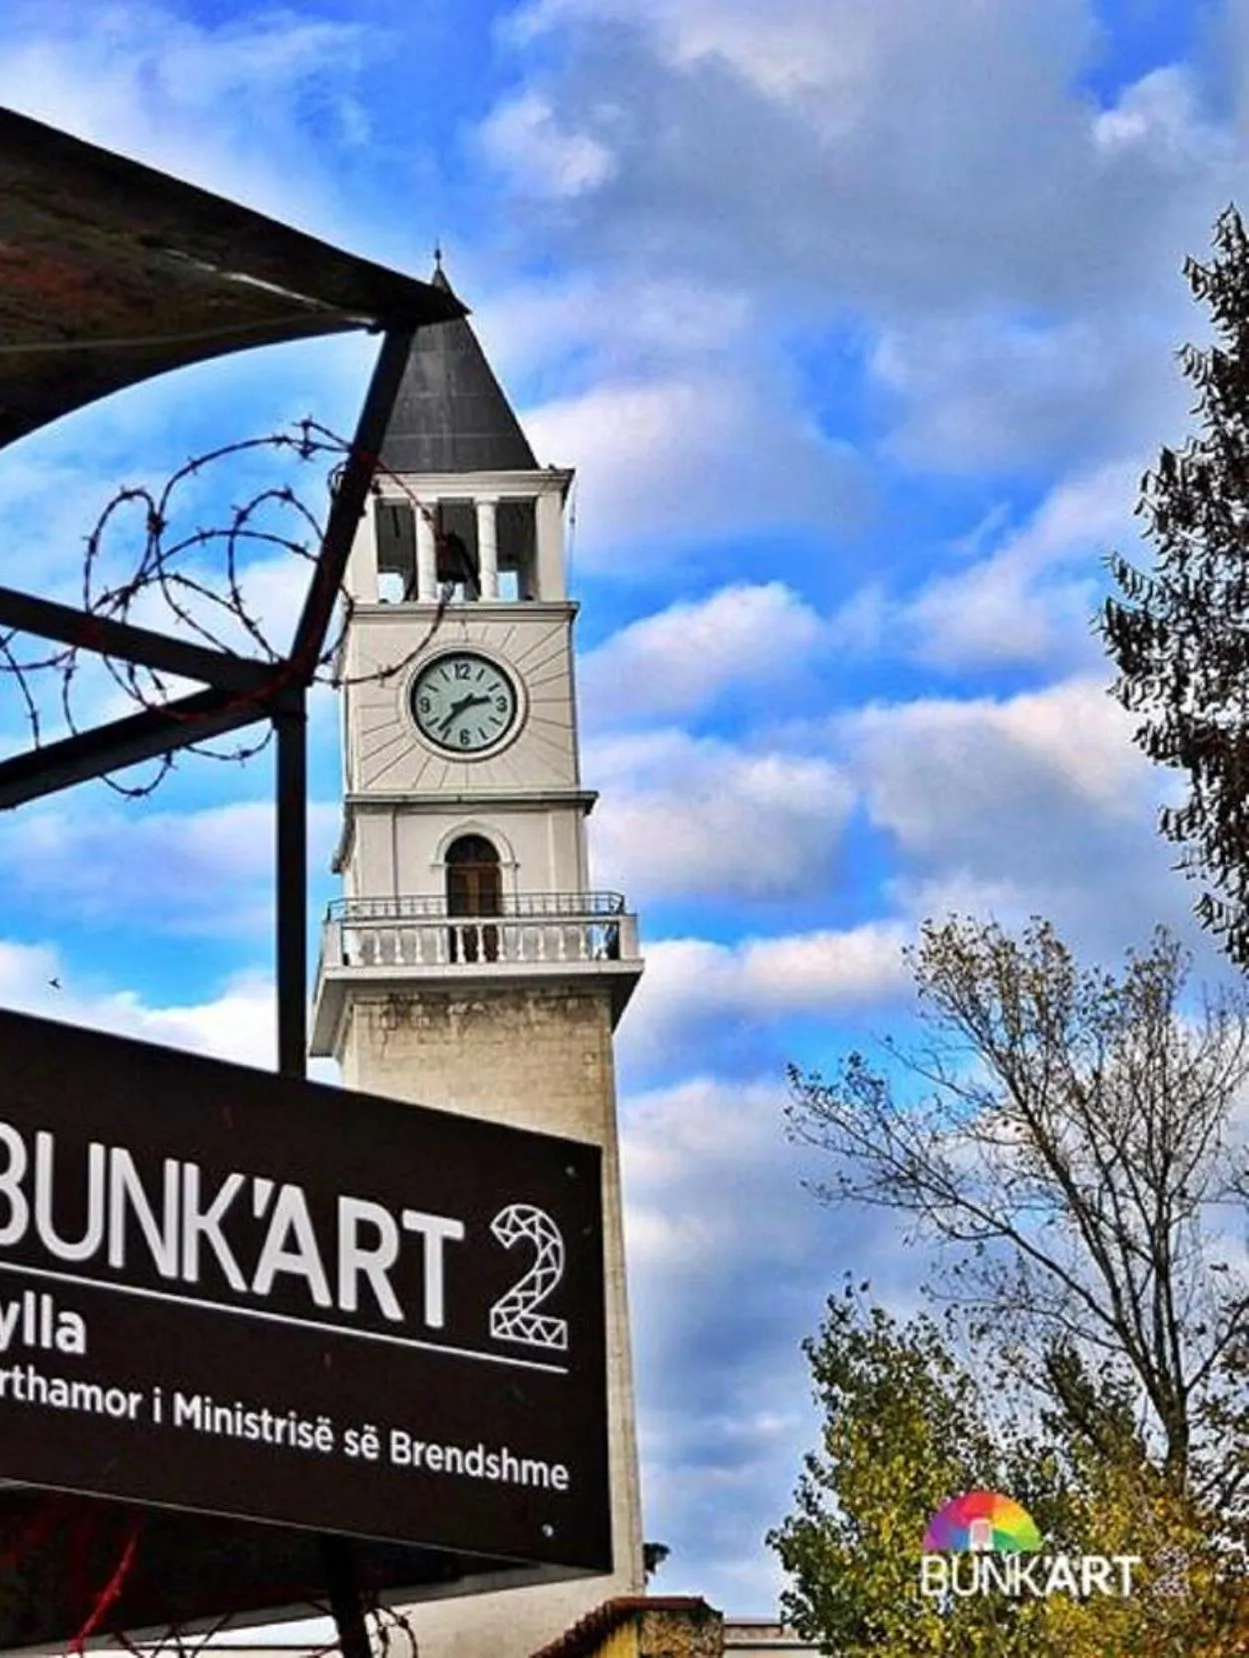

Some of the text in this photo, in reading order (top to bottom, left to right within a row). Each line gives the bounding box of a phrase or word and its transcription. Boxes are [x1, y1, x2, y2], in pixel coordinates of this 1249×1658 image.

[453, 663, 471, 681] 12
[419, 696, 431, 714] 9
[496, 696, 508, 713] 3
[459, 729, 471, 746] 6
[489, 1203, 568, 1350] 2
[152, 1387, 162, 1422] i
[173, 1391, 335, 1453] Ministrisë
[344, 1423, 381, 1459] së
[390, 1430, 570, 1491] Brendshme
